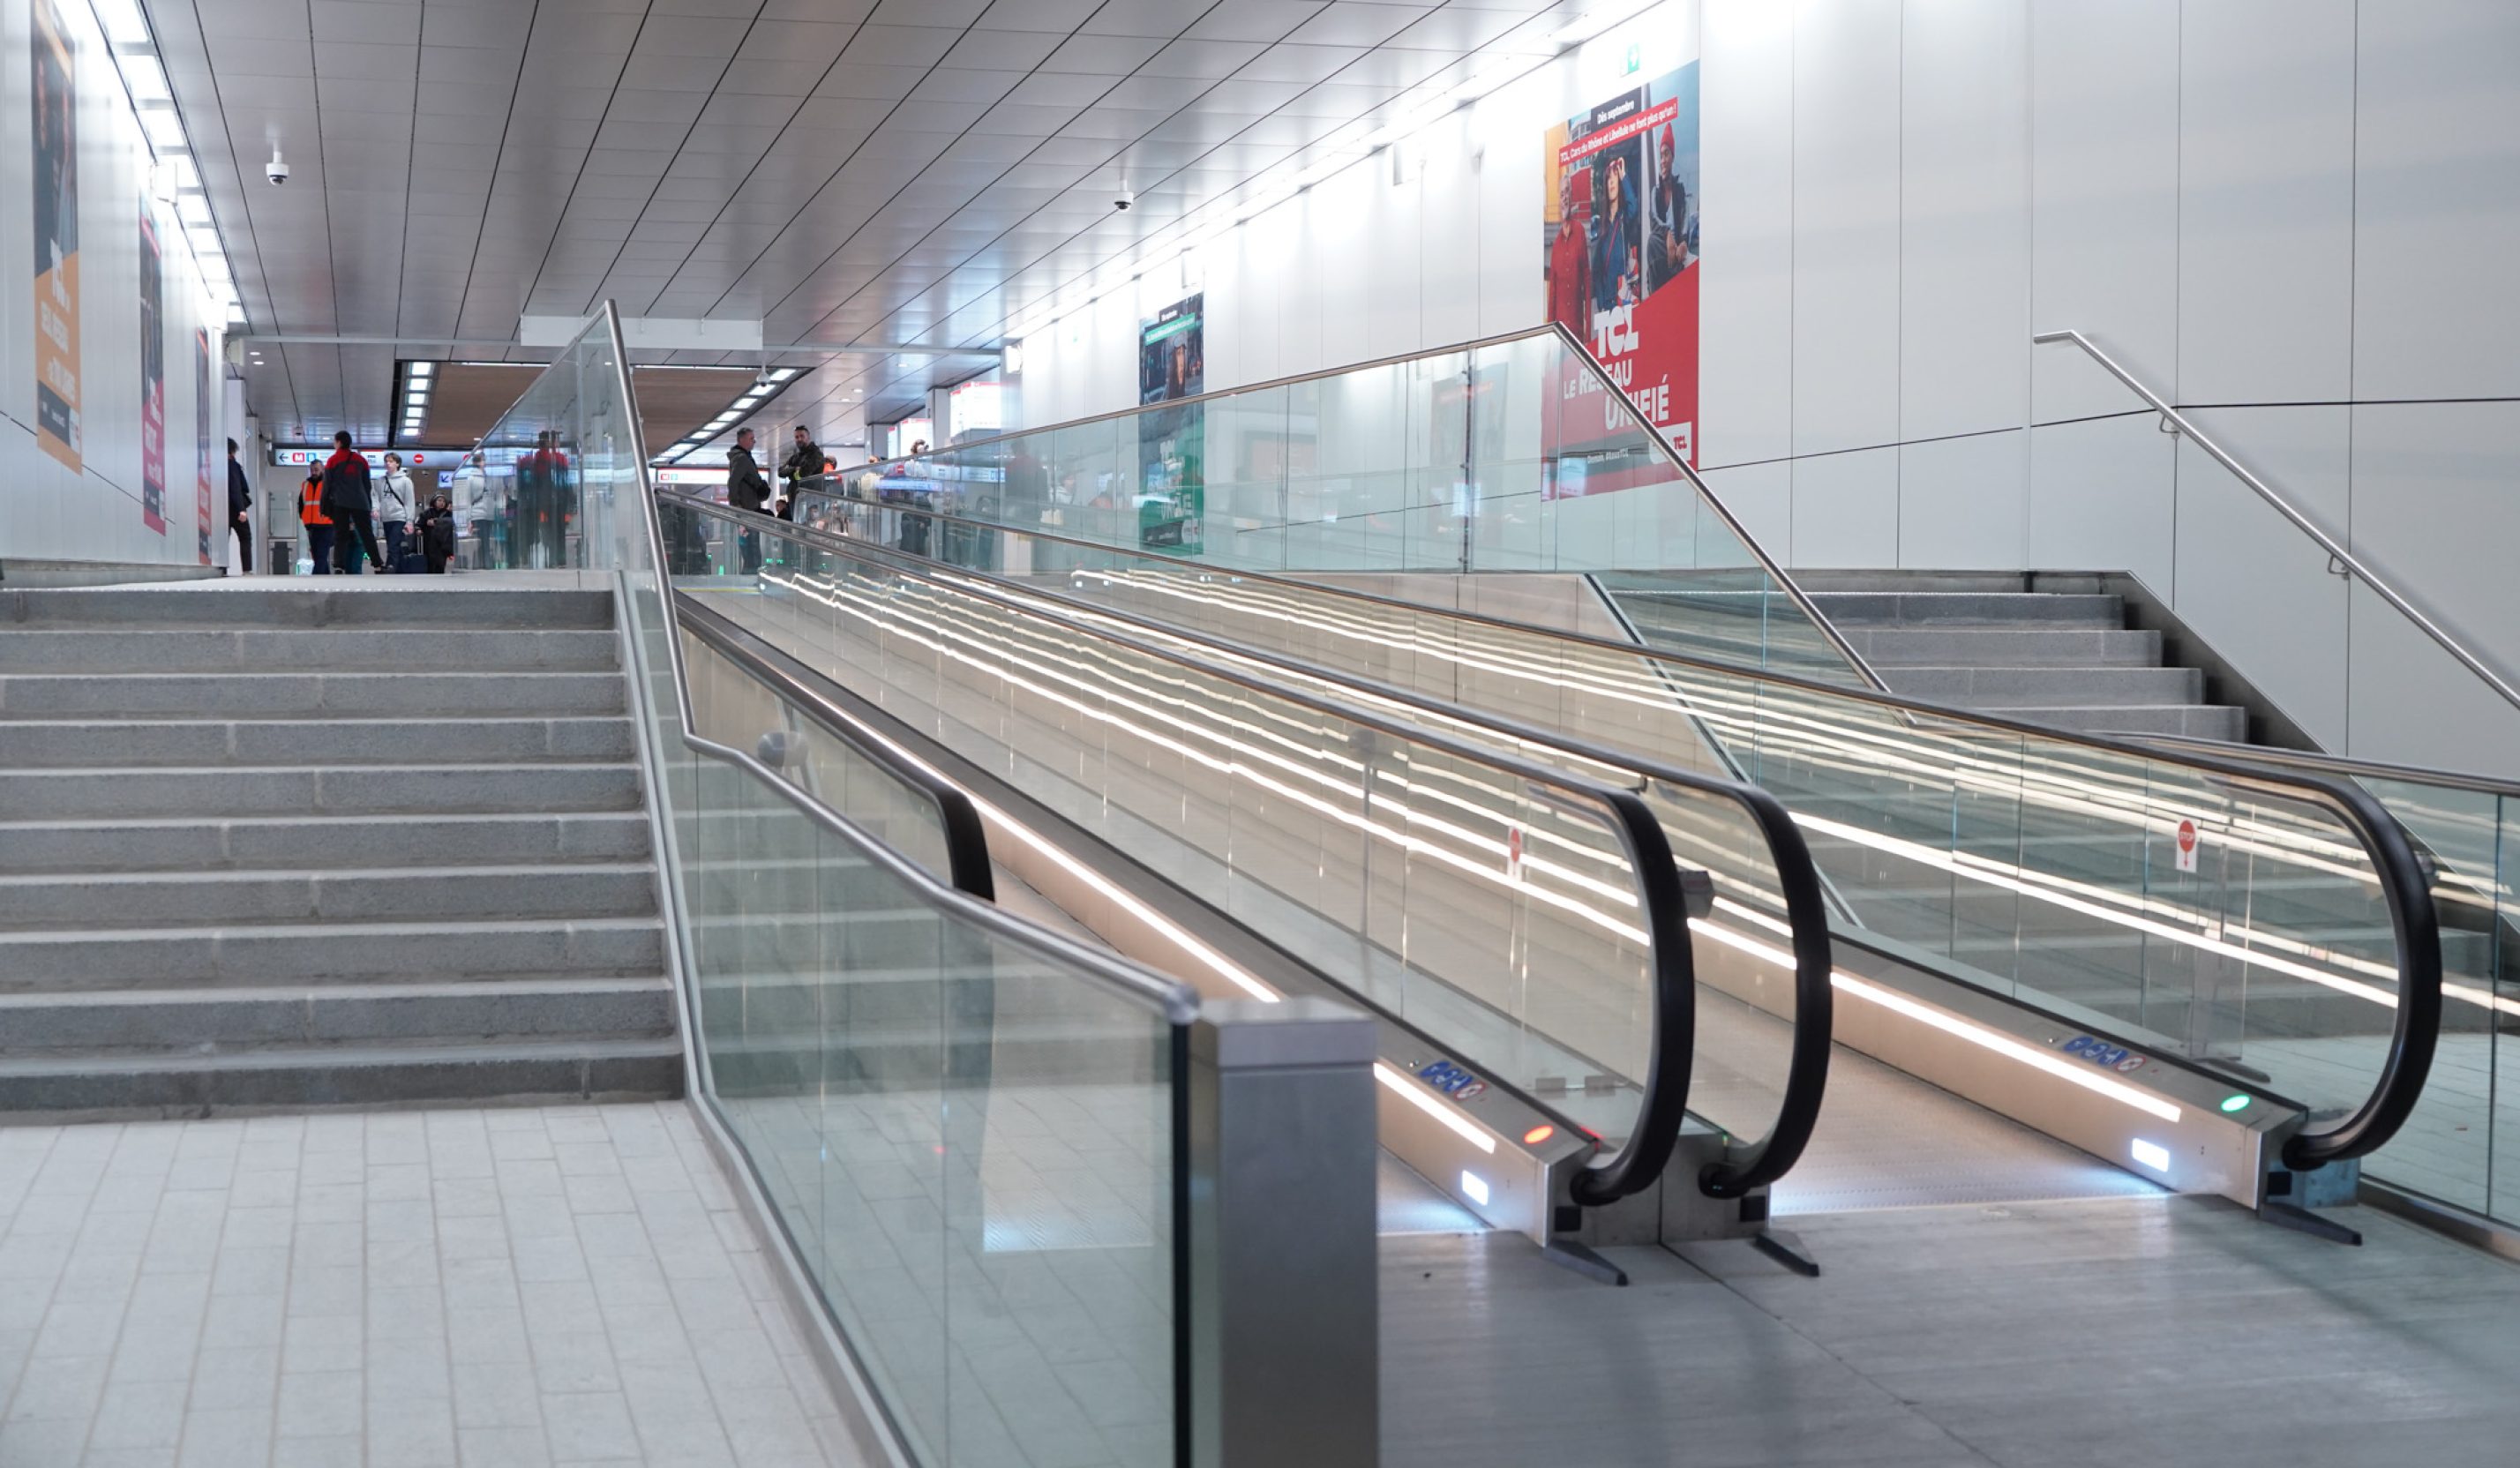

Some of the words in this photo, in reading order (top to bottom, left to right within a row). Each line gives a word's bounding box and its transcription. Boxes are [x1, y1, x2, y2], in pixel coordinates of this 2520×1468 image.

[1608, 100, 1635, 120] septembre
[1594, 303, 1639, 359] TCL
[1564, 378, 1576, 400] LE
[1579, 359, 1632, 395] REAU
[1673, 435, 1688, 450] TCL
[2180, 832, 2195, 842] STOP
